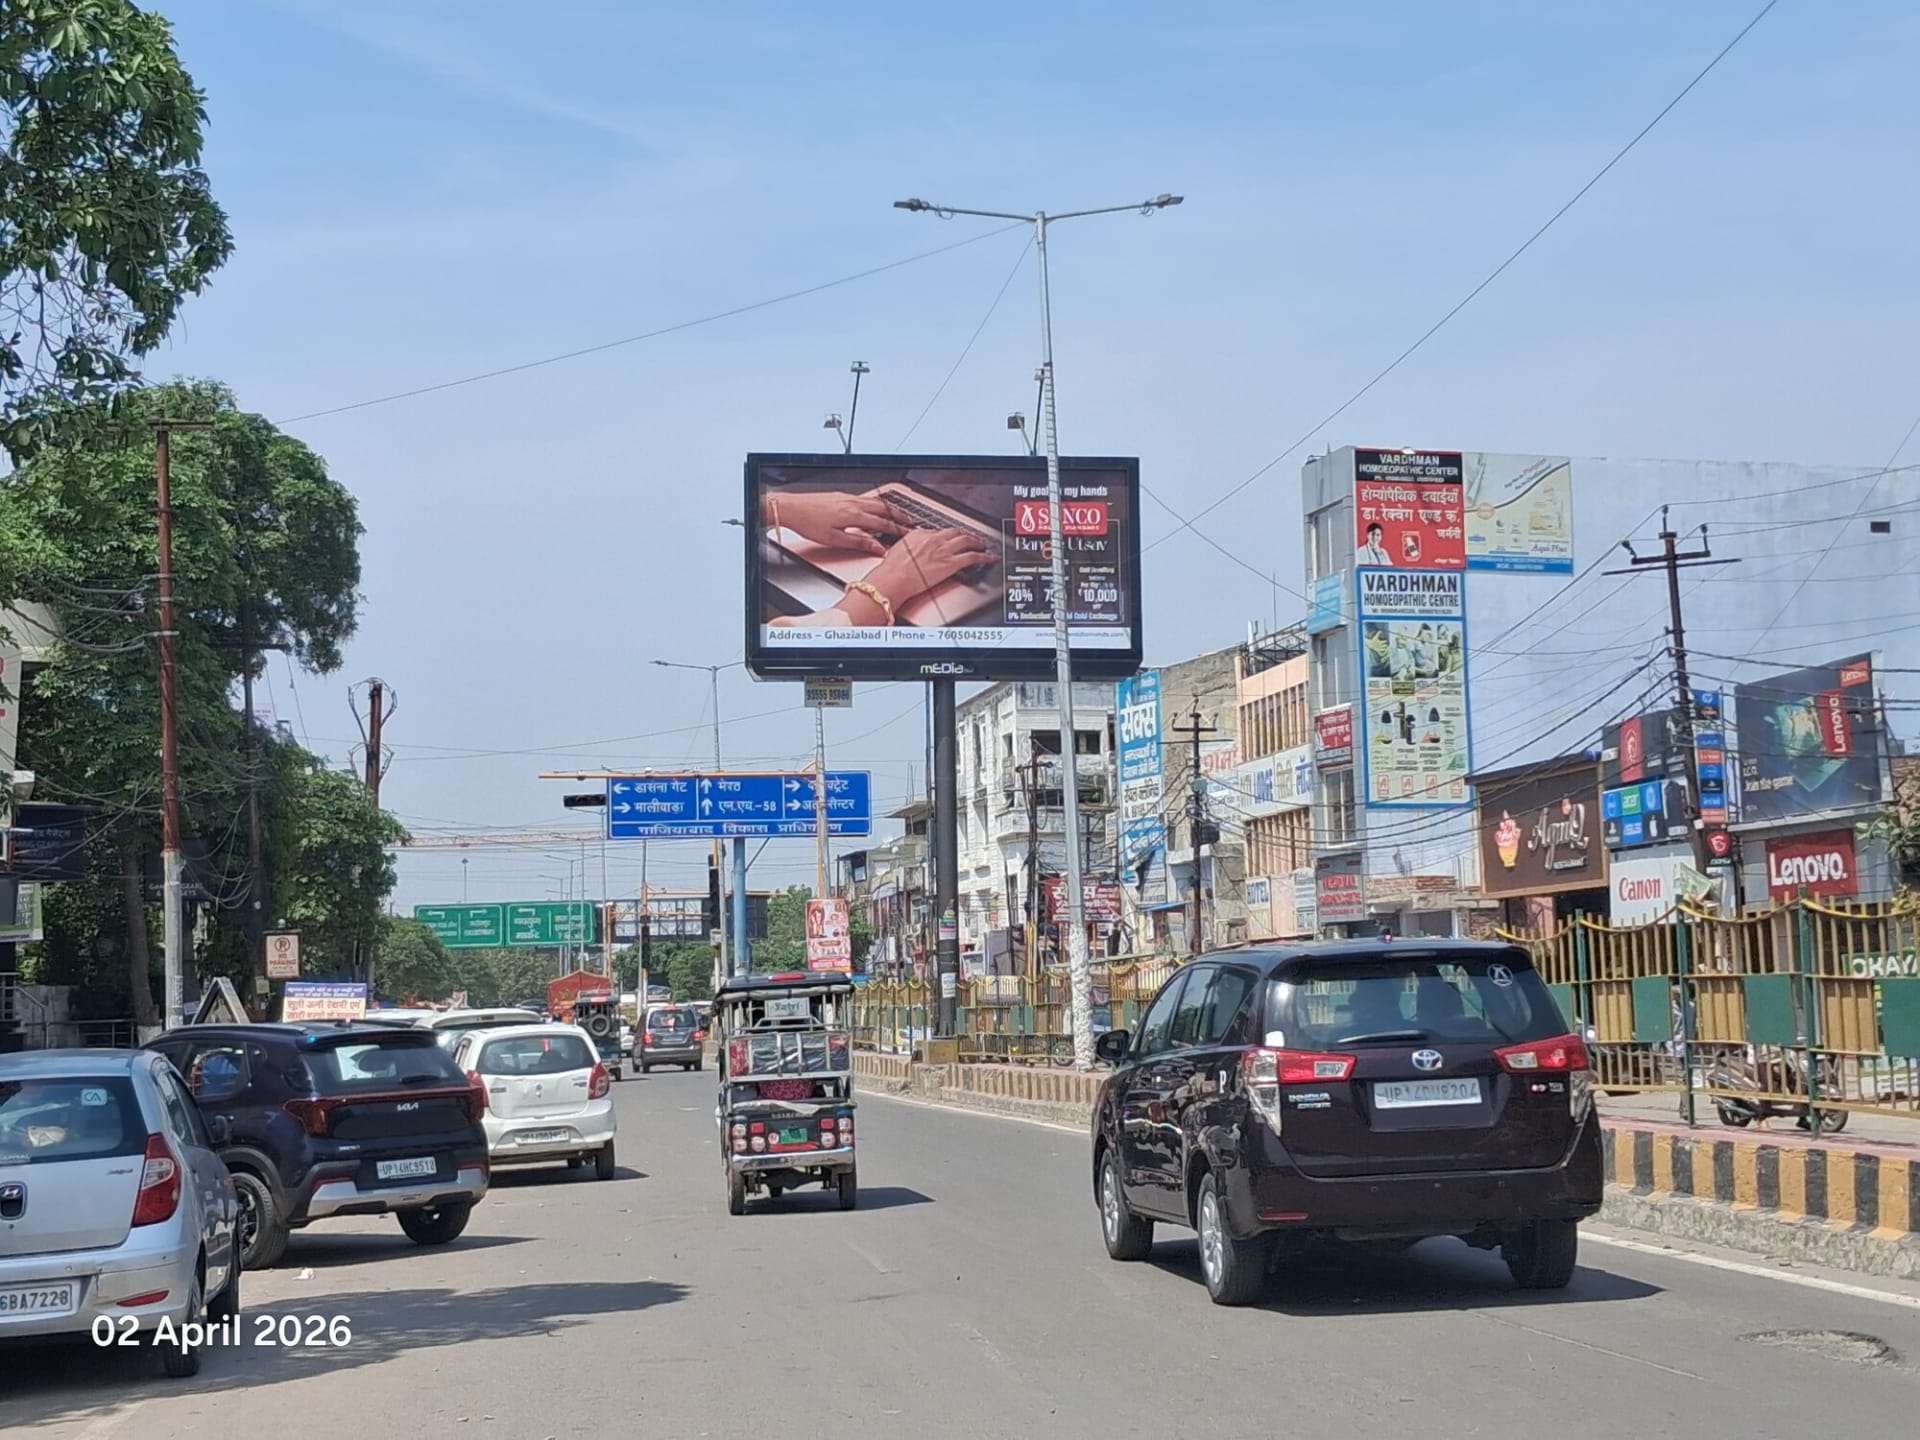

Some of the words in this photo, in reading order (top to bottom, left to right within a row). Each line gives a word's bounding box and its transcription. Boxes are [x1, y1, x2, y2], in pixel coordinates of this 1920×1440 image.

[1379, 454, 1440, 466] VARDHMAN
[1425, 466, 1458, 476] CENTER
[1013, 485, 1028, 497] My
[1064, 487, 1078, 498] my
[1080, 485, 1108, 496] hands
[1038, 508, 1101, 524] SNCO
[1365, 574, 1457, 592] VARDHMAN
[1008, 588, 1033, 602] 20%
[1364, 593, 1428, 607] HOMOEOPATHIC
[1429, 594, 1459, 607] CENTRE
[768, 630, 813, 640] Address
[824, 629, 881, 640] Ghaziabad
[891, 630, 926, 640] Phone
[937, 630, 1003, 641] 7605042555
[1828, 694, 1847, 753] Lenovo
[1618, 875, 1662, 902] Canon
